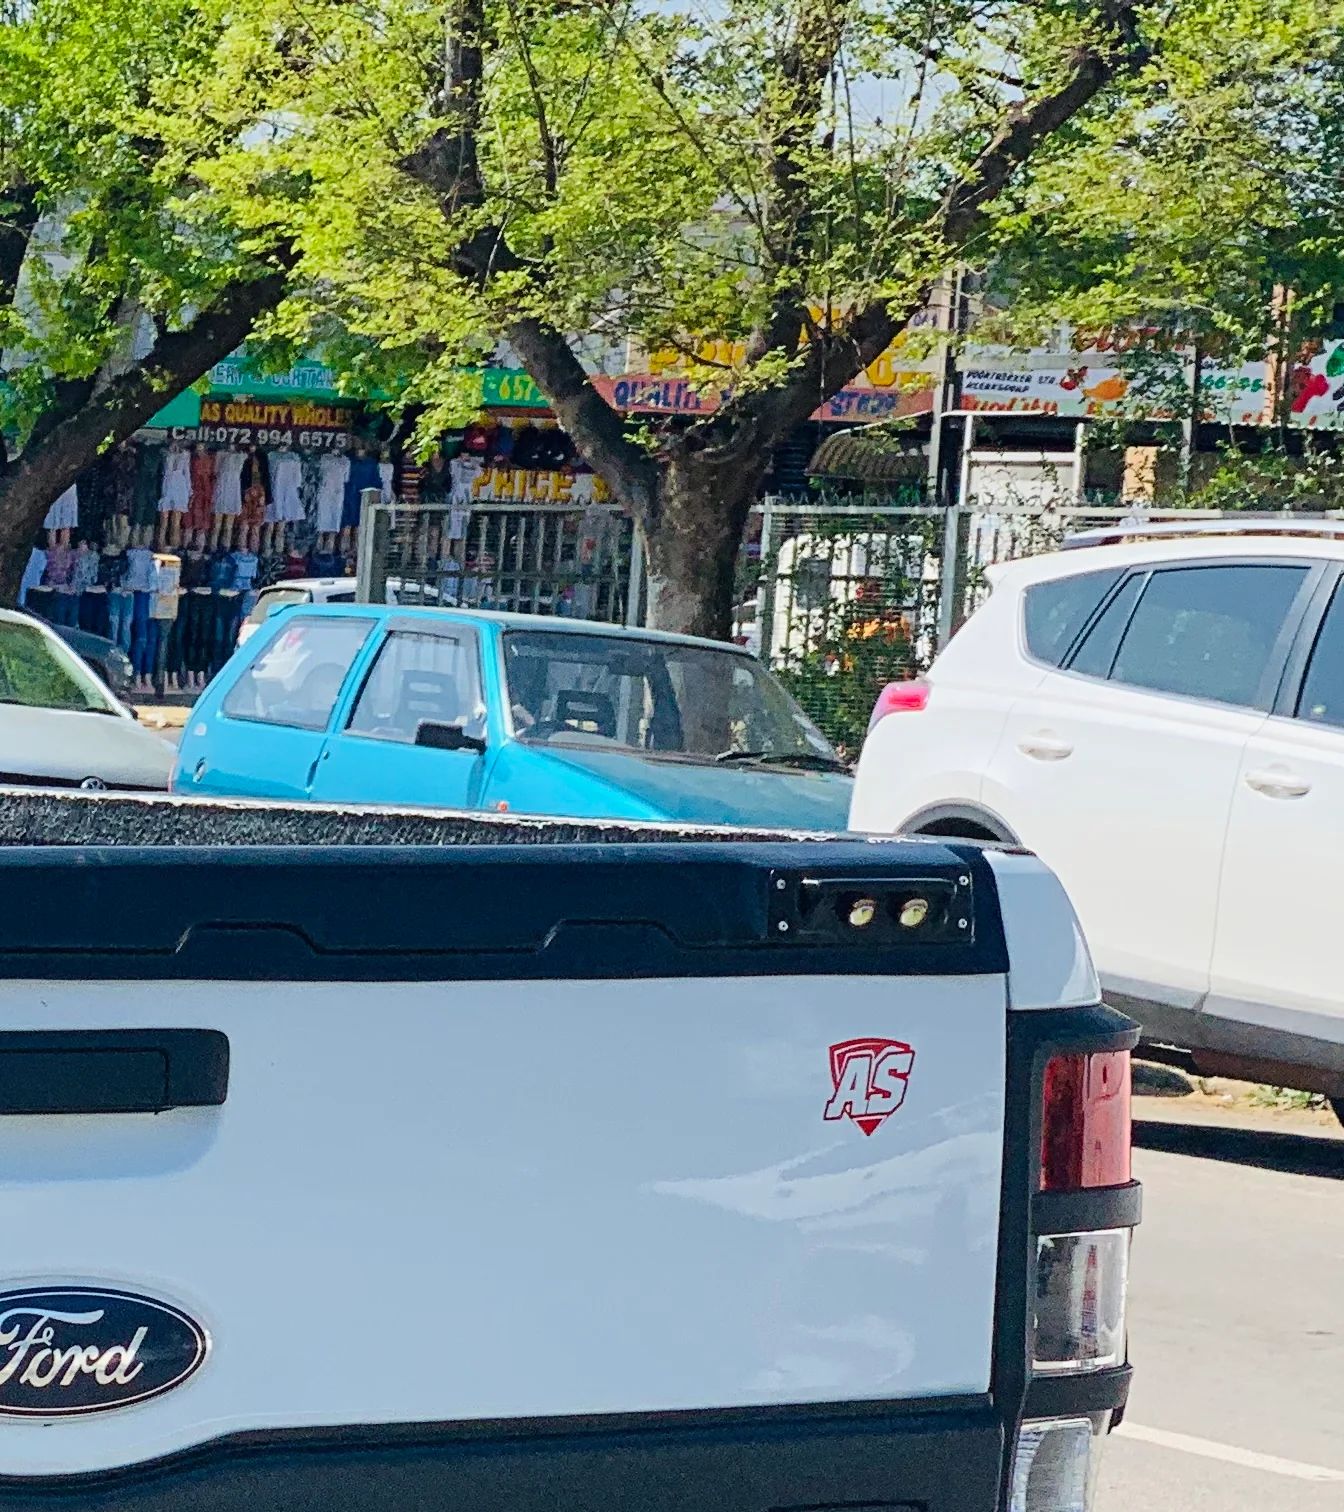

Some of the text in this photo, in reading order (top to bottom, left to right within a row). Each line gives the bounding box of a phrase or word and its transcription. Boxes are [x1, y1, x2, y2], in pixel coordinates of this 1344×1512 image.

[200, 402, 221, 422] AS
[224, 403, 291, 425] QUALITY
[257, 428, 293, 446] 994
[299, 430, 348, 448] 6575
[823, 1049, 915, 1121] AS
